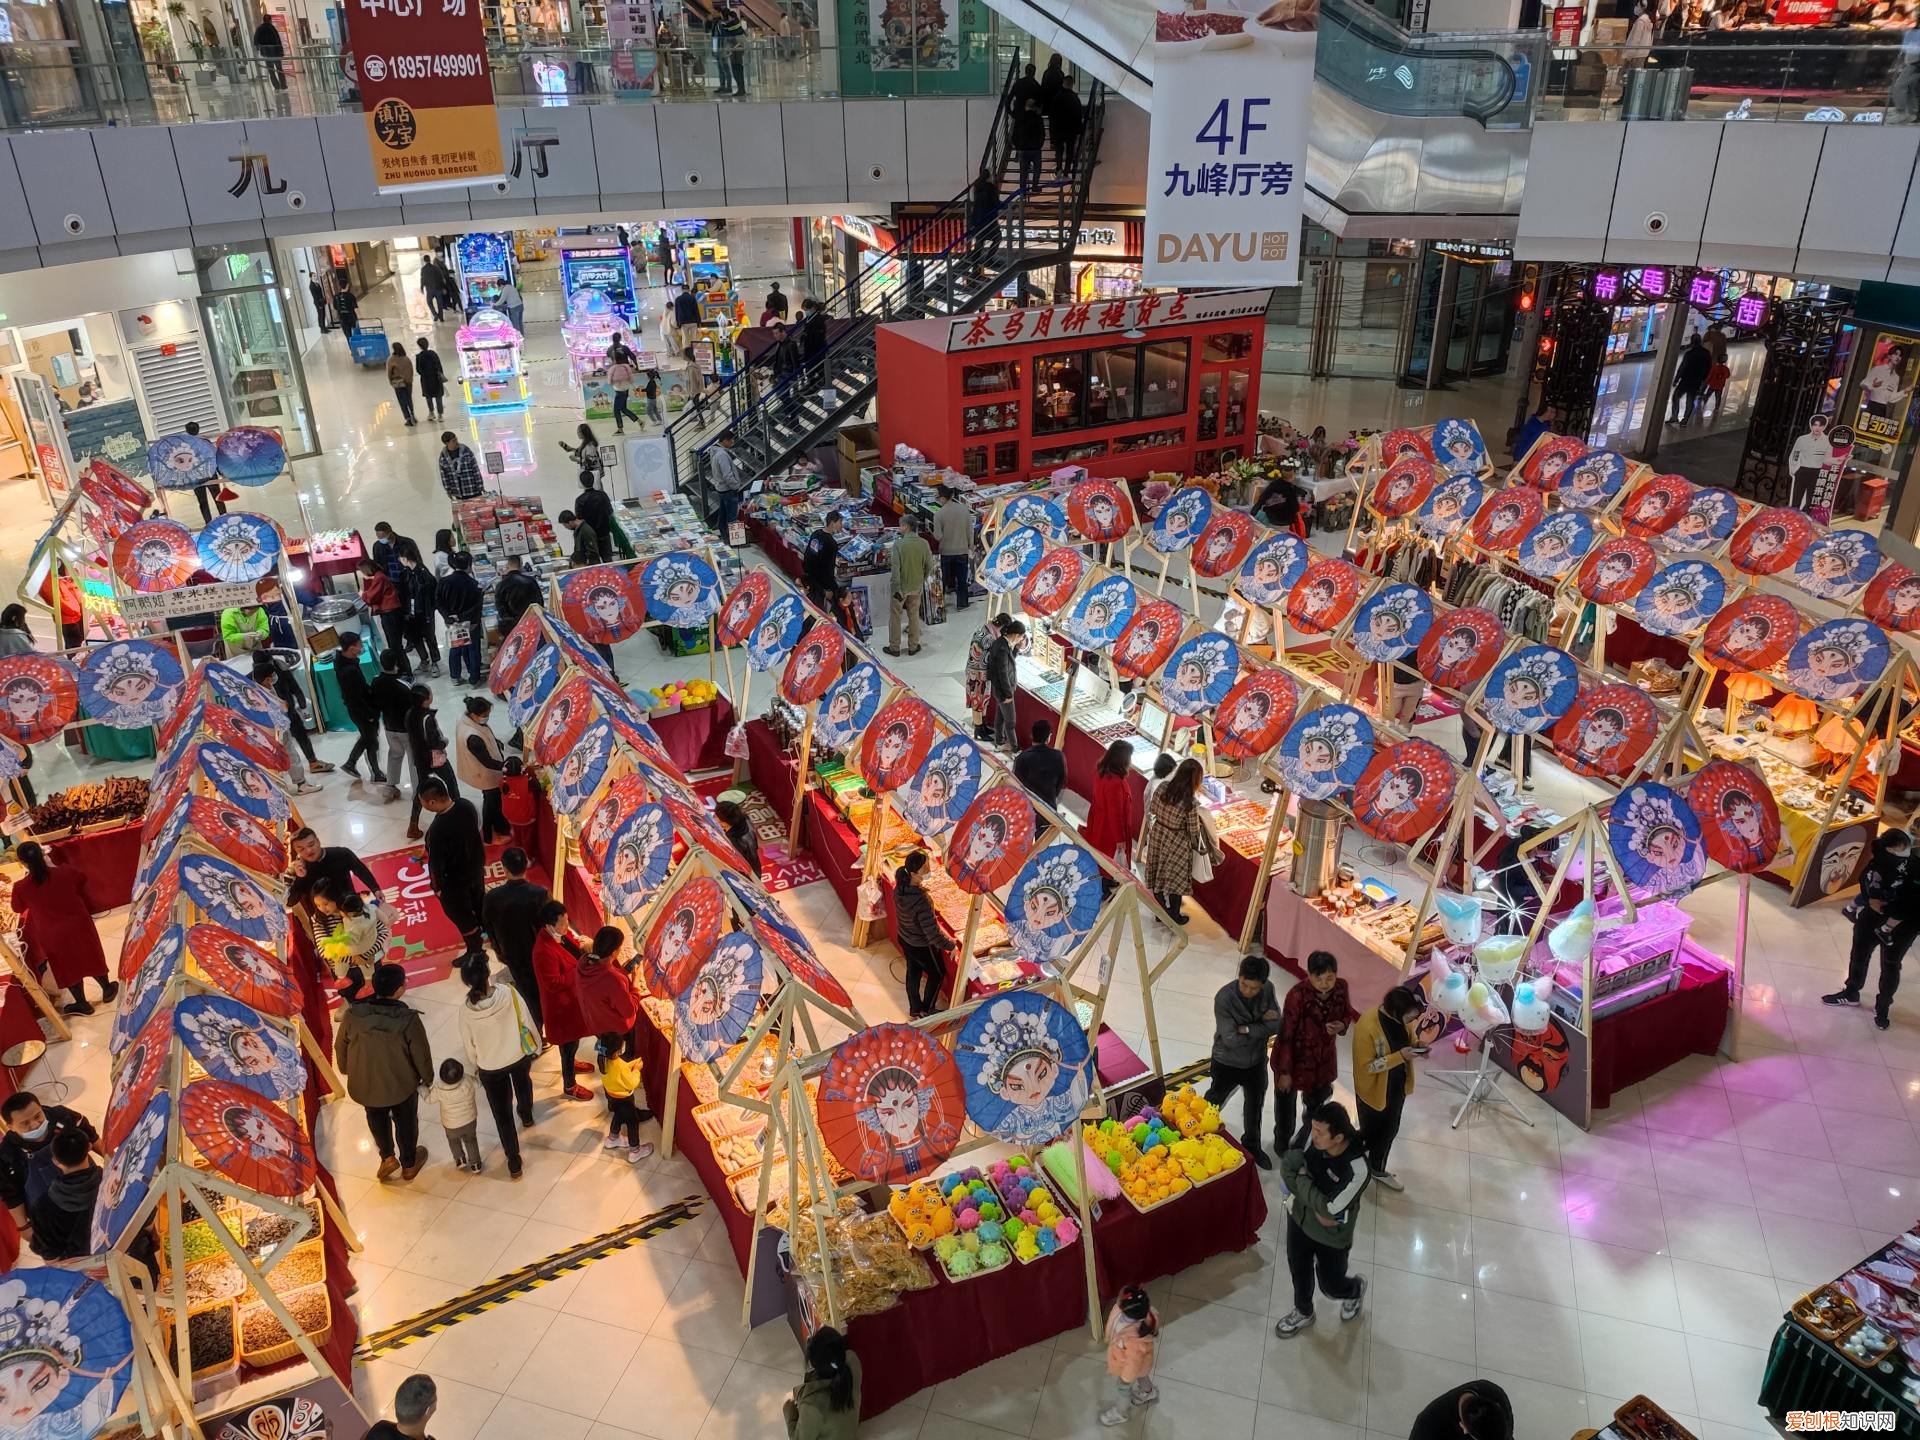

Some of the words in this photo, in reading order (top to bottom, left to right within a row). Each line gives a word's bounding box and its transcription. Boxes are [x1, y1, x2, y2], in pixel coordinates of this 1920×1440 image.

[389, 54, 483, 79] 18957499901
[382, 125, 413, 146] 之宝
[1196, 98, 1271, 155] 4F
[227, 140, 287, 198] 九
[510, 128, 559, 179] 厅
[384, 171, 402, 180] ZHU
[403, 168, 436, 178] HUOHUO
[438, 165, 478, 175] BARBECUE
[1164, 161, 1293, 197] 九峰厅旁
[1157, 232, 1257, 263] DAYU
[1263, 234, 1287, 244] HOT
[1262, 249, 1285, 258] POT
[961, 292, 1189, 346] 茶马月饼提货点
[504, 532, 524, 543] 3-6
